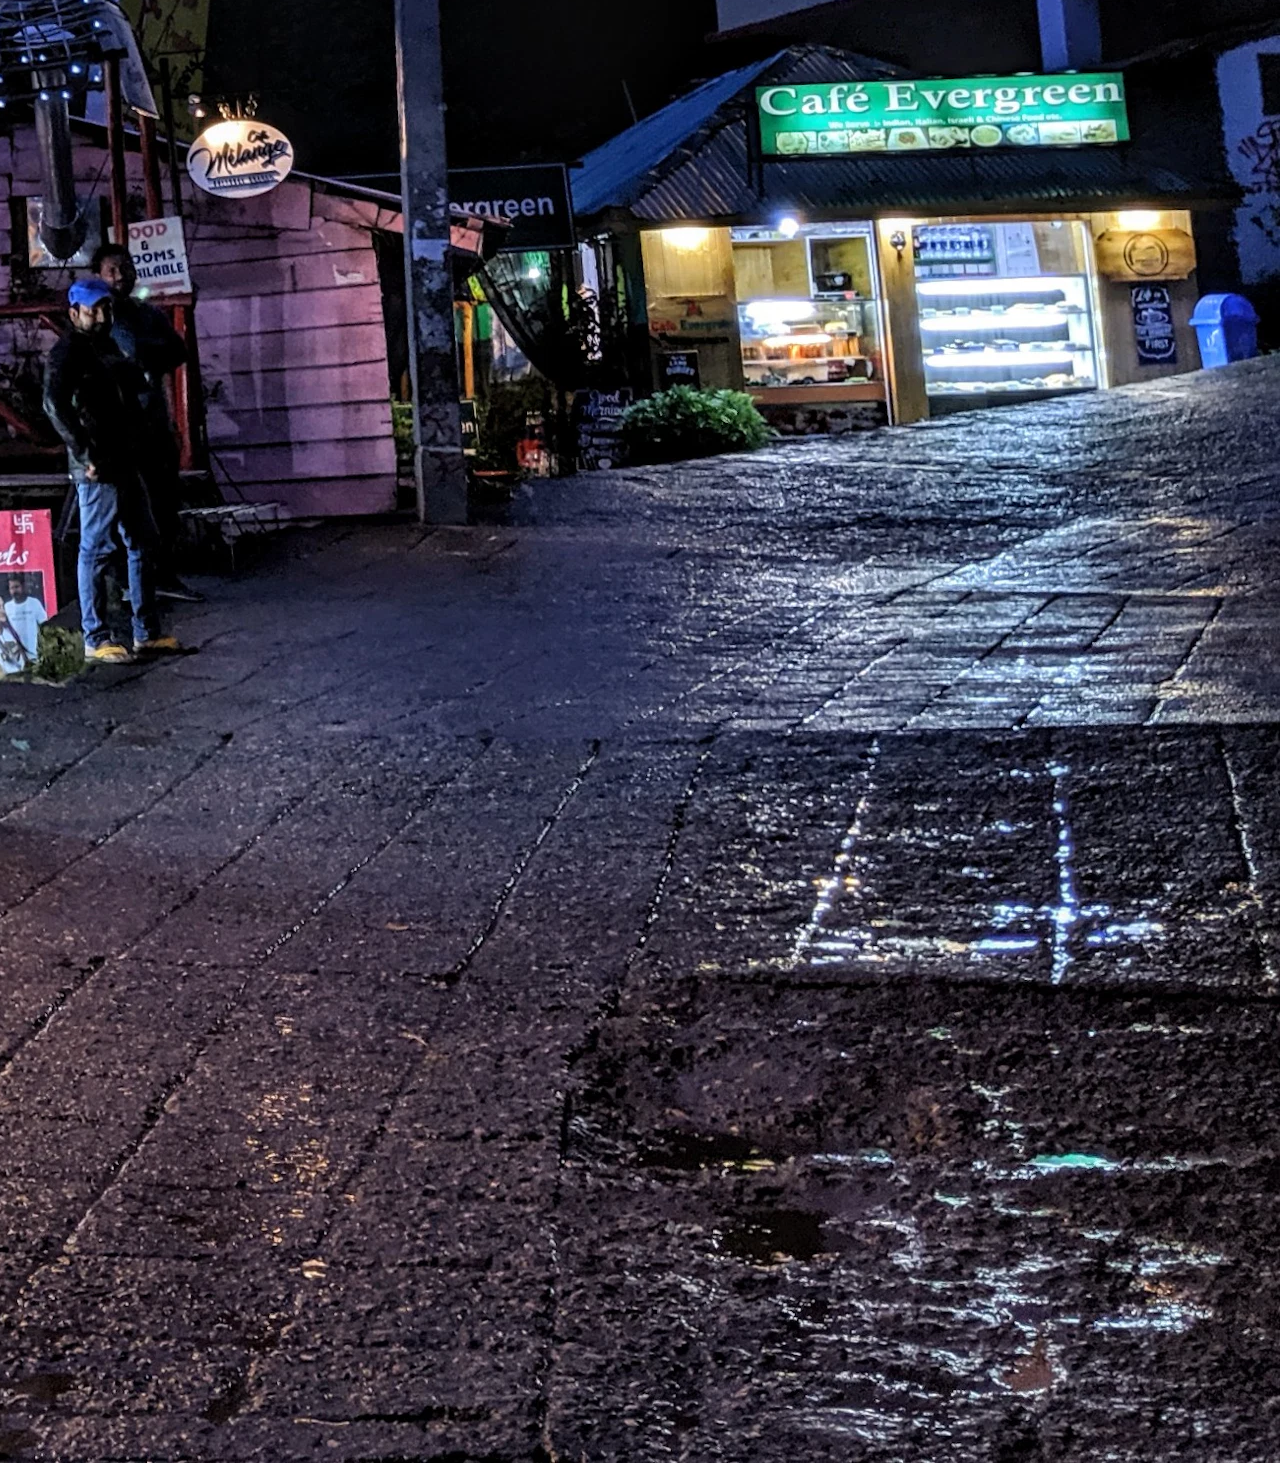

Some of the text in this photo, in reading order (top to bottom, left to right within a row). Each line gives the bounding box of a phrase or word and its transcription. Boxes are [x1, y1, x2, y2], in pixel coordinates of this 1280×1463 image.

[759, 82, 1124, 116] Café Evergreen
[129, 223, 168, 240] OOD
[132, 249, 176, 265] OOMS
